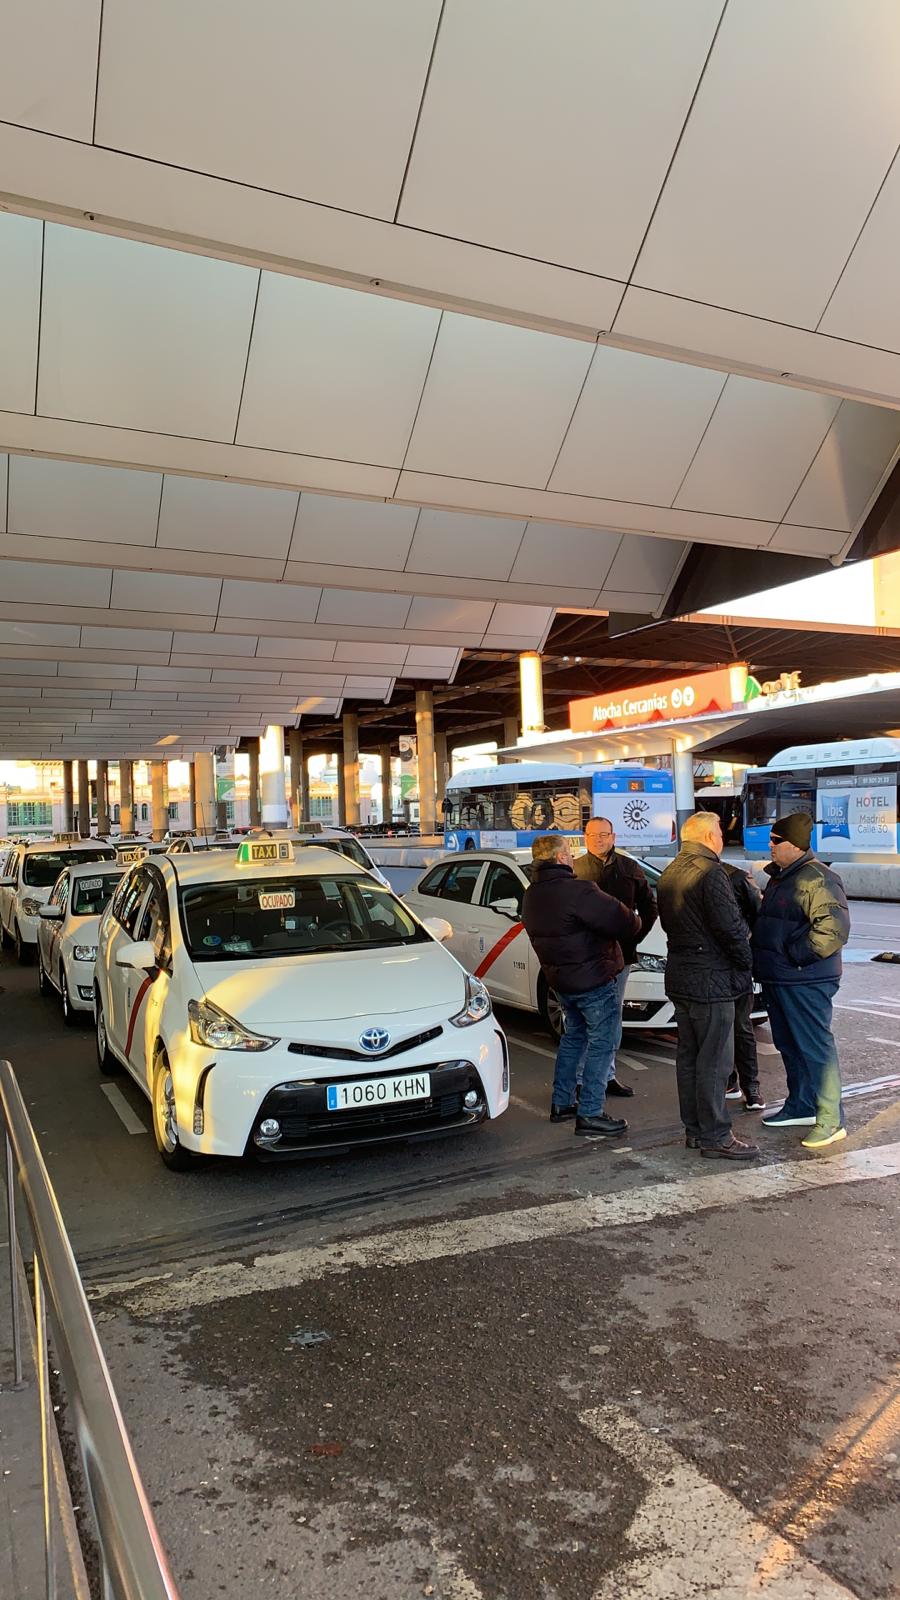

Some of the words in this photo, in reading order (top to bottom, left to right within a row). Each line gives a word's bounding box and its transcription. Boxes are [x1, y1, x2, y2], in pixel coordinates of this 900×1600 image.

[593, 702, 622, 721] Atocha
[623, 692, 668, 716] Cercanías
[856, 796, 889, 807] HOTEL
[827, 805, 844, 816] ibis
[860, 814, 886, 824] Madrid
[857, 825, 876, 834] Calle
[878, 825, 888, 834] 30
[252, 844, 277, 858] TAXI
[262, 894, 294, 908] OCUPADO
[343, 1083, 386, 1104] 1060
[393, 1077, 426, 1098] KHN
